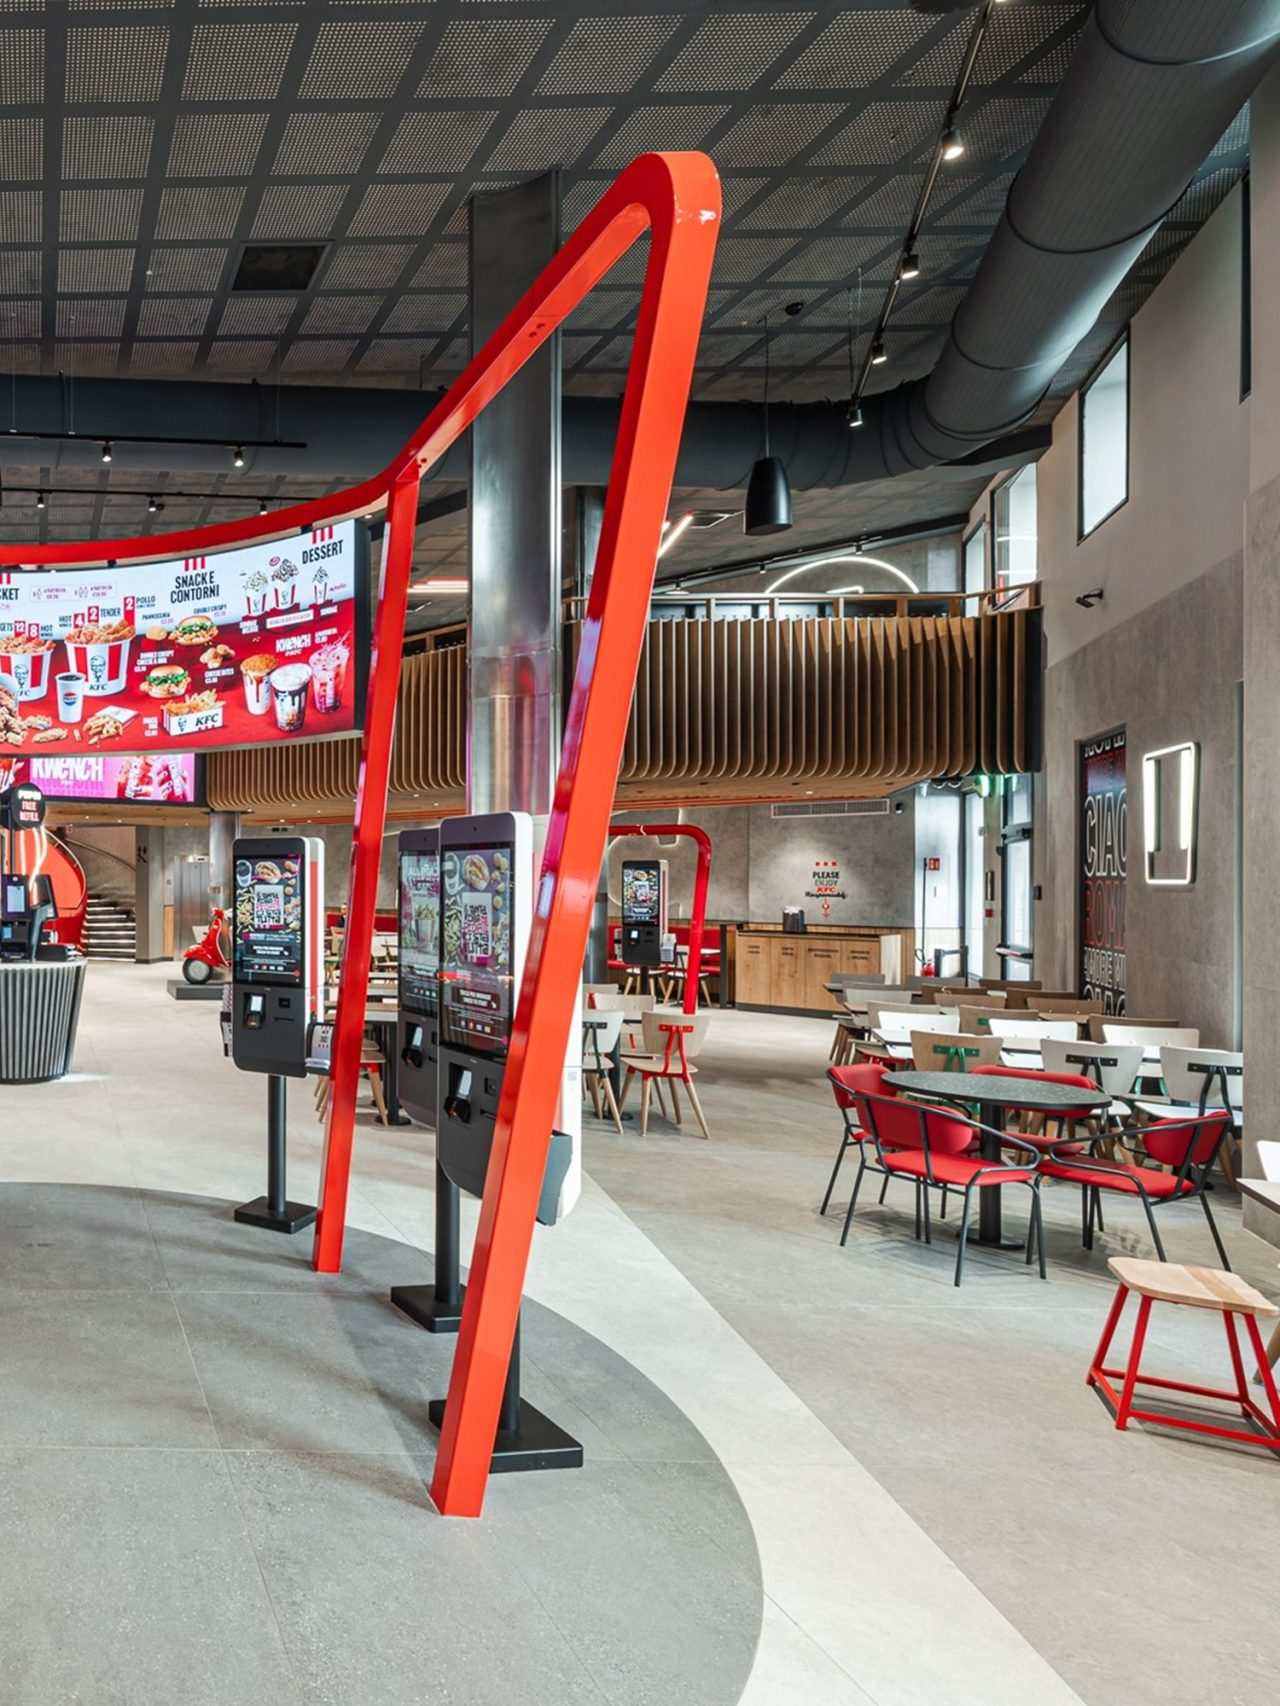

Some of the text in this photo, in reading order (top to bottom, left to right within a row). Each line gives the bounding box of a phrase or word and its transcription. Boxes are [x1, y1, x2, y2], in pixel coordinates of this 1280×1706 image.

[302, 539, 343, 565] DESSERT
[175, 571, 215, 589] SNACK E
[170, 584, 220, 604] CONTORNI
[89, 607, 121, 620] 2 TENDER
[15, 622, 25, 632] 12
[29, 625, 38, 637] 8
[195, 713, 219, 726] KFC
[812, 871, 840, 879] PLEASE
